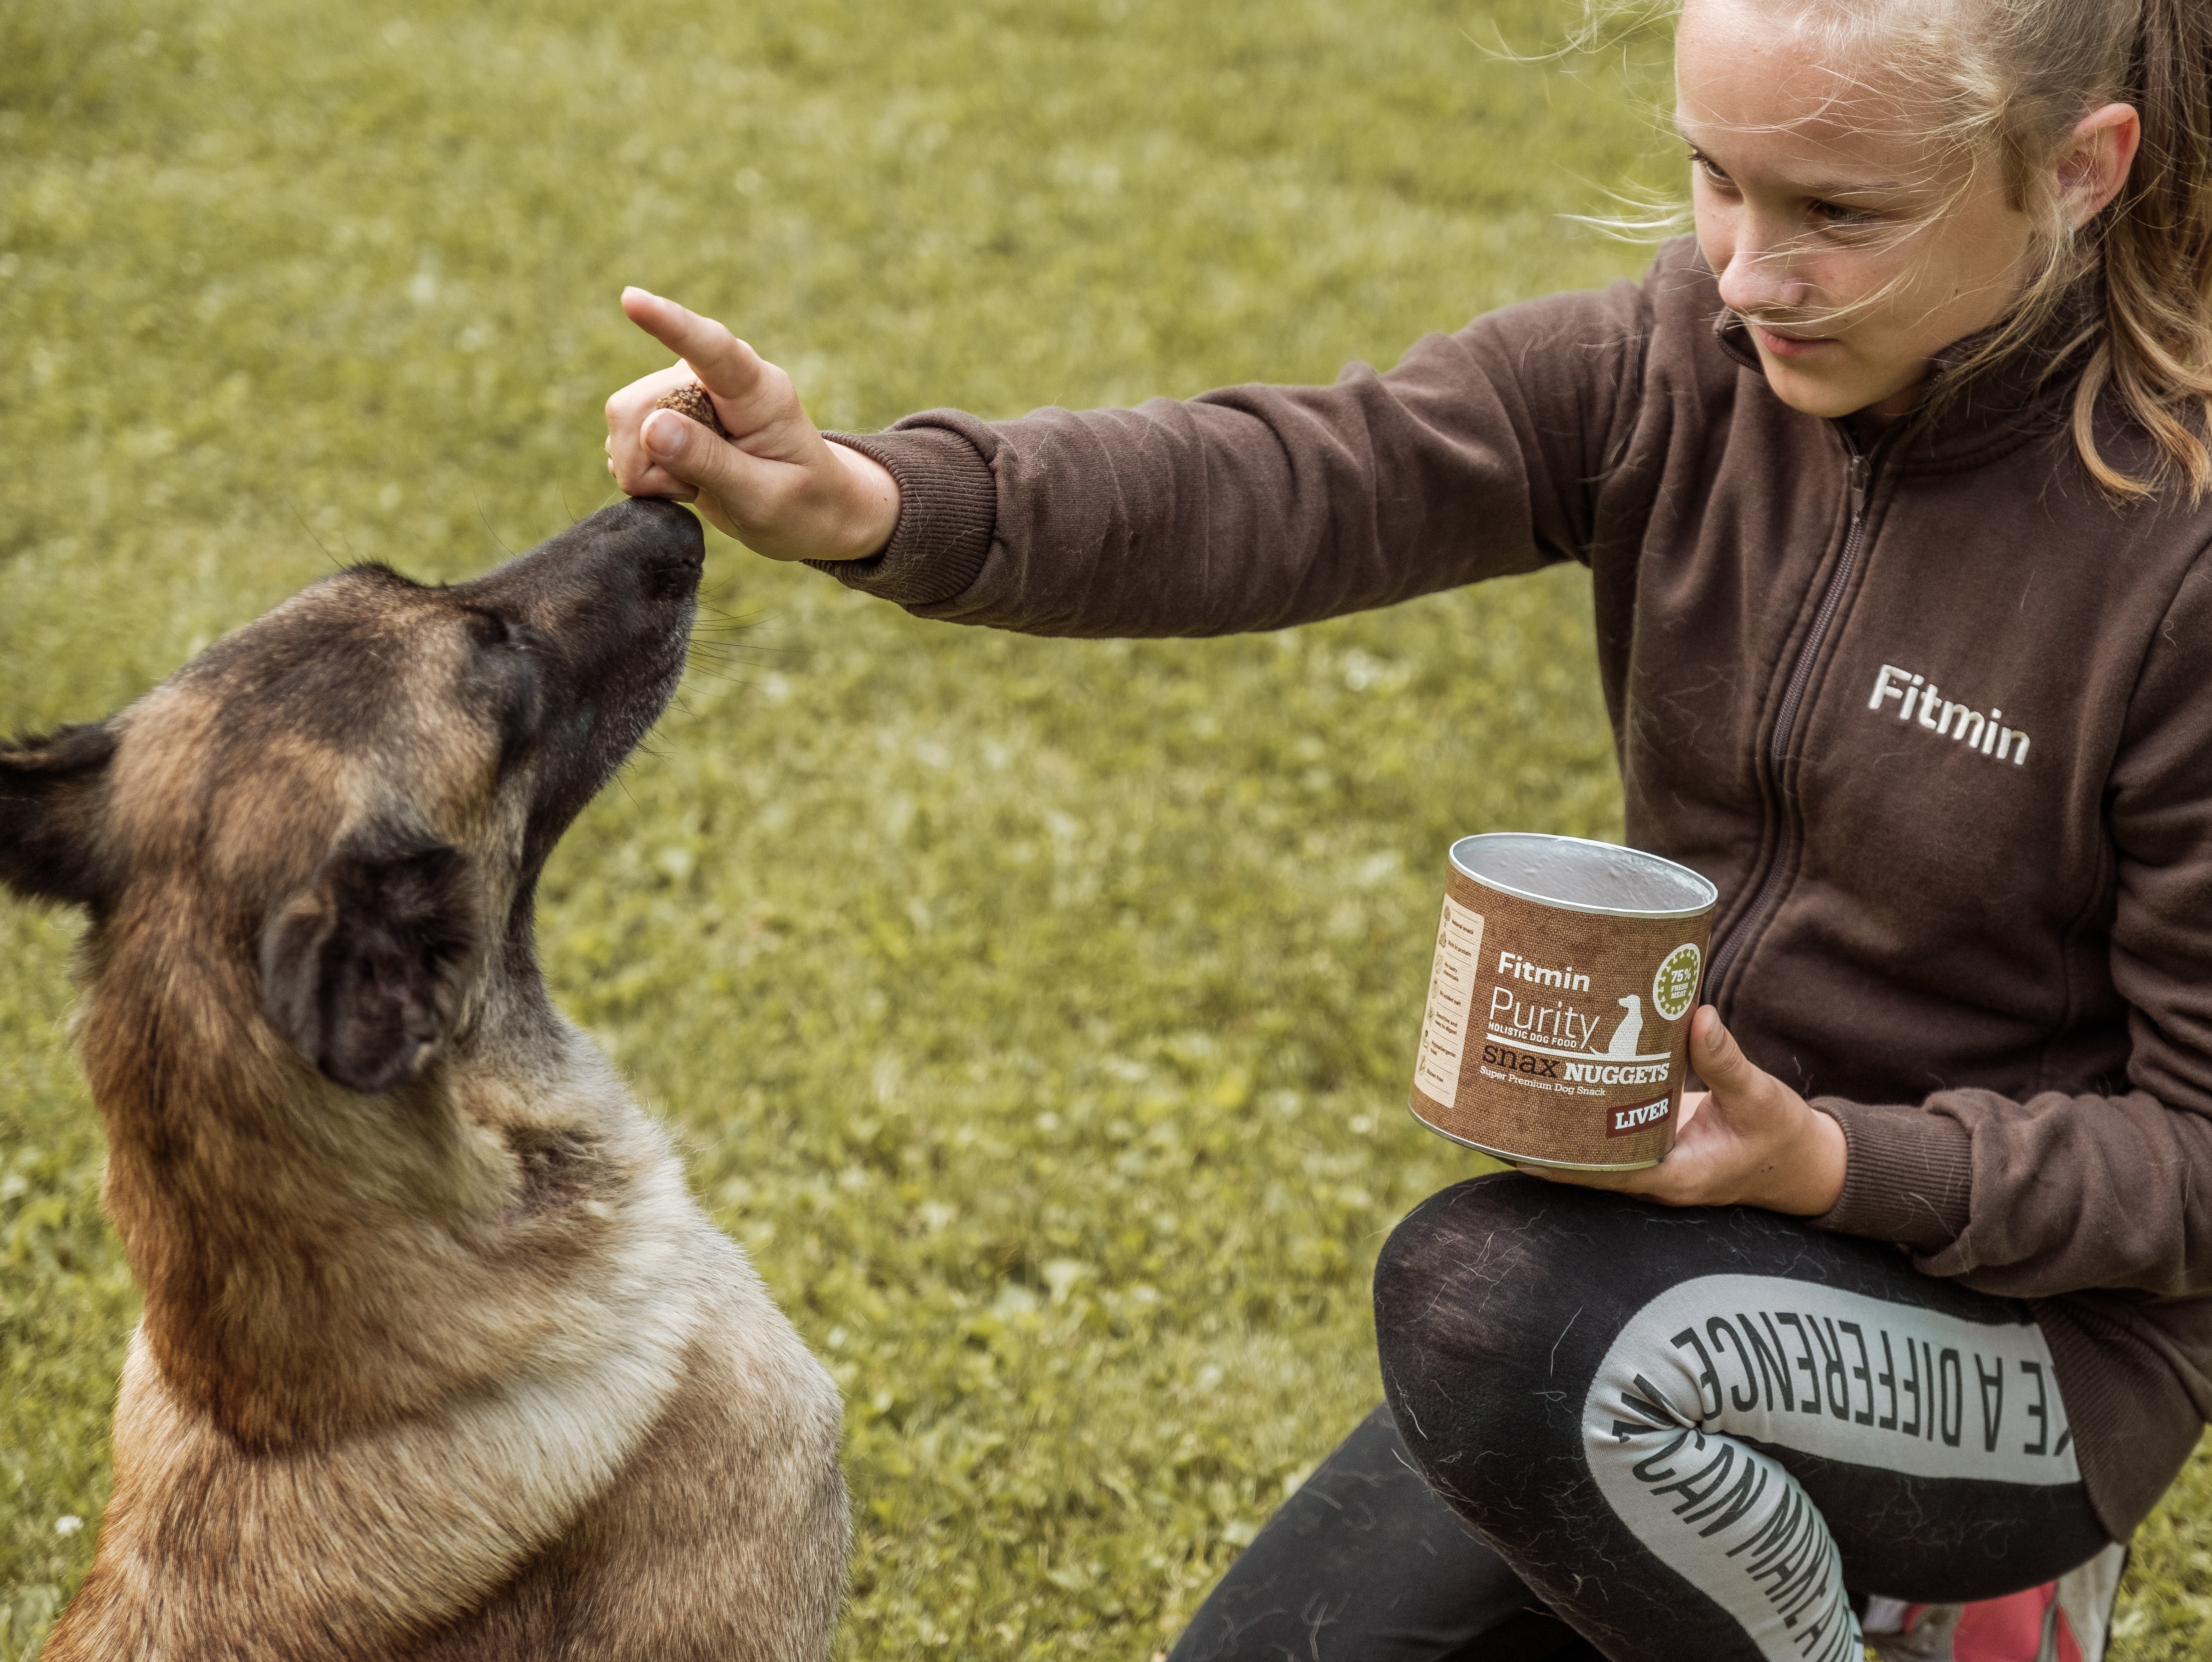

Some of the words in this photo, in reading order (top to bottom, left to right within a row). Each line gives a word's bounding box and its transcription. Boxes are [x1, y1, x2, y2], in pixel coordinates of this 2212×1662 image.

[1868, 664, 2031, 765] Fitmin
[1498, 951, 1590, 992] Fitmin
[1671, 967, 1692, 983] 75%
[1671, 982, 1689, 992] FRESH
[1670, 989, 1687, 999] MEAT
[1488, 1021, 1528, 1038] HOLISTIC
[1530, 1032, 1549, 1044] DOG
[1551, 1037, 1577, 1048] FOOD
[1490, 986, 1601, 1050] Purity
[1480, 1065, 1507, 1080] Super
[1507, 1073, 1552, 1091] Premium
[1554, 1083, 1576, 1095] Dog
[1576, 1086, 1606, 1096] Snack
[1482, 1045, 1560, 1078] snax
[1563, 1062, 1670, 1084] NUGGETS
[1615, 1098, 1669, 1129] LIVER
[1670, 1311, 1962, 1447] DIFFERENCE
[1974, 1353, 2003, 1451] A
